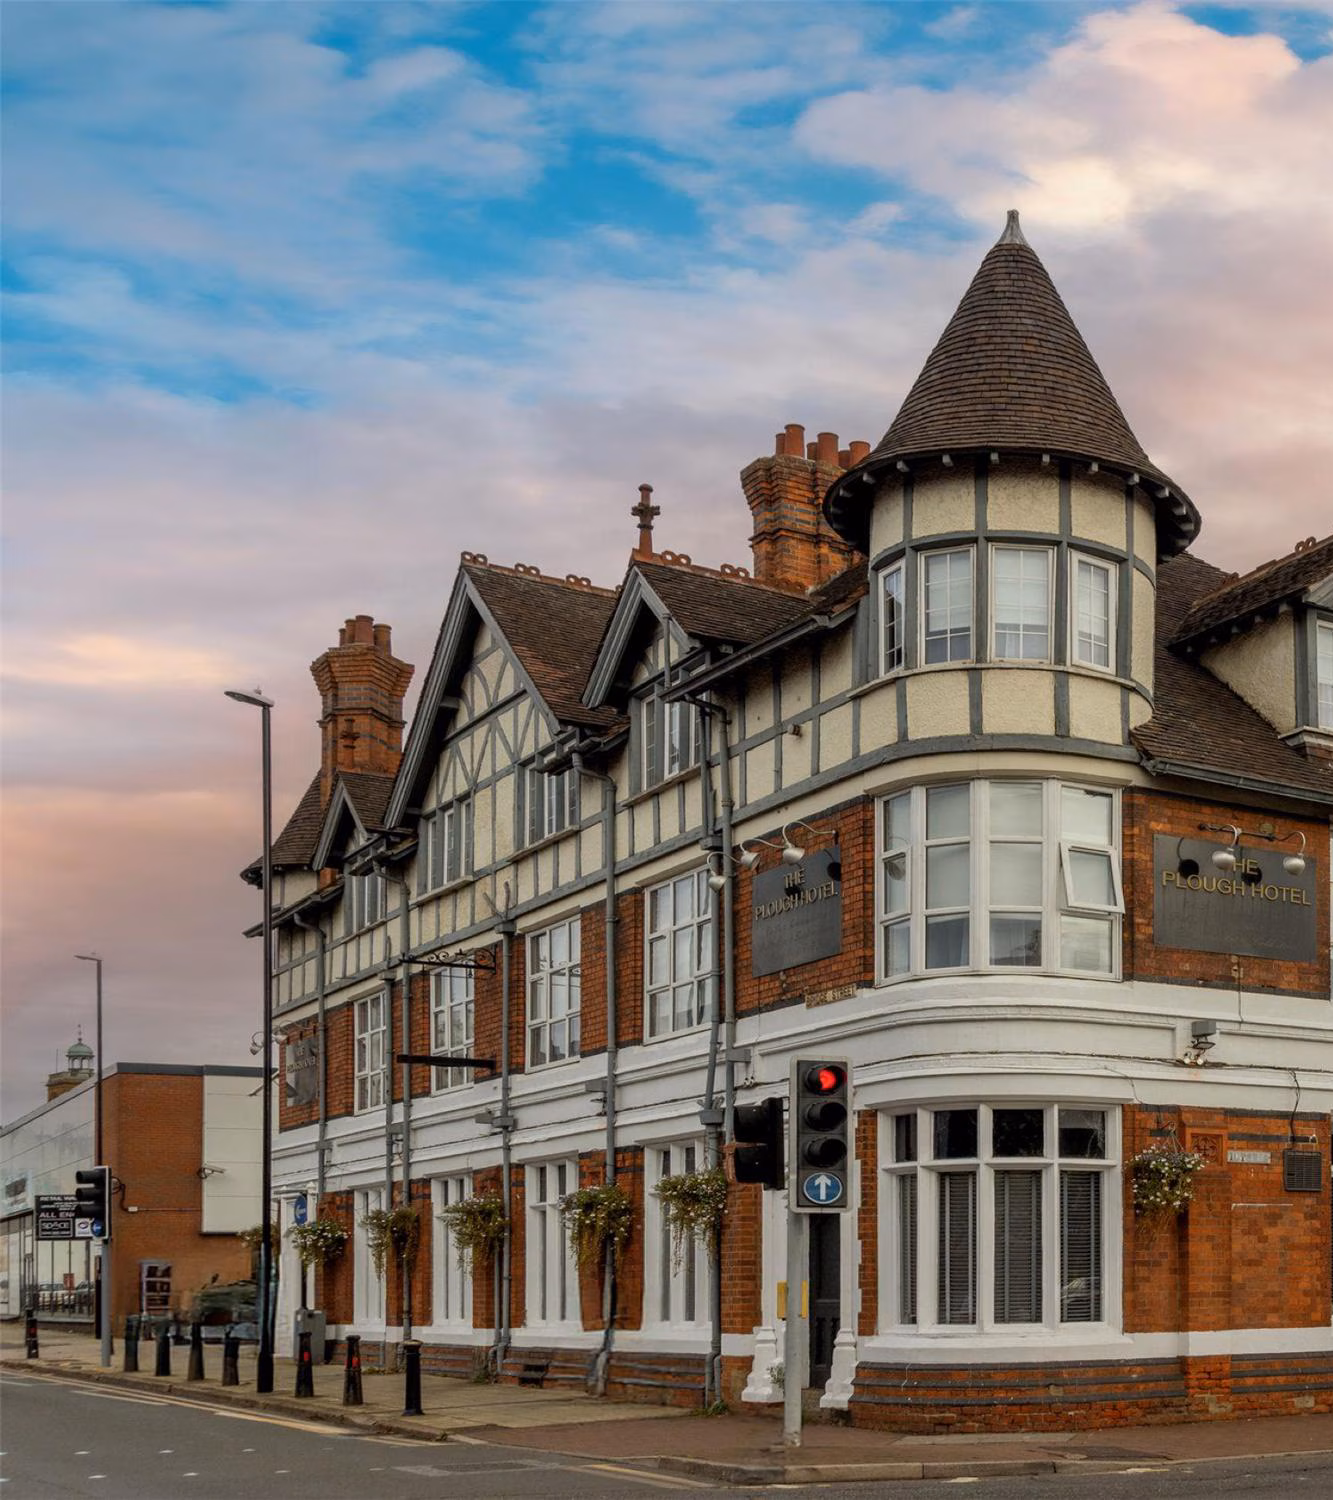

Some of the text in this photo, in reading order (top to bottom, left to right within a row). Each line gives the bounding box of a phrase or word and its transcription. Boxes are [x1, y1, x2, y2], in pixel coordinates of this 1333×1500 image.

[784, 868, 806, 889] THE
[1162, 871, 1312, 906] PLOUGH HOTEL
[755, 880, 839, 921] PLOUGH HOTEL
